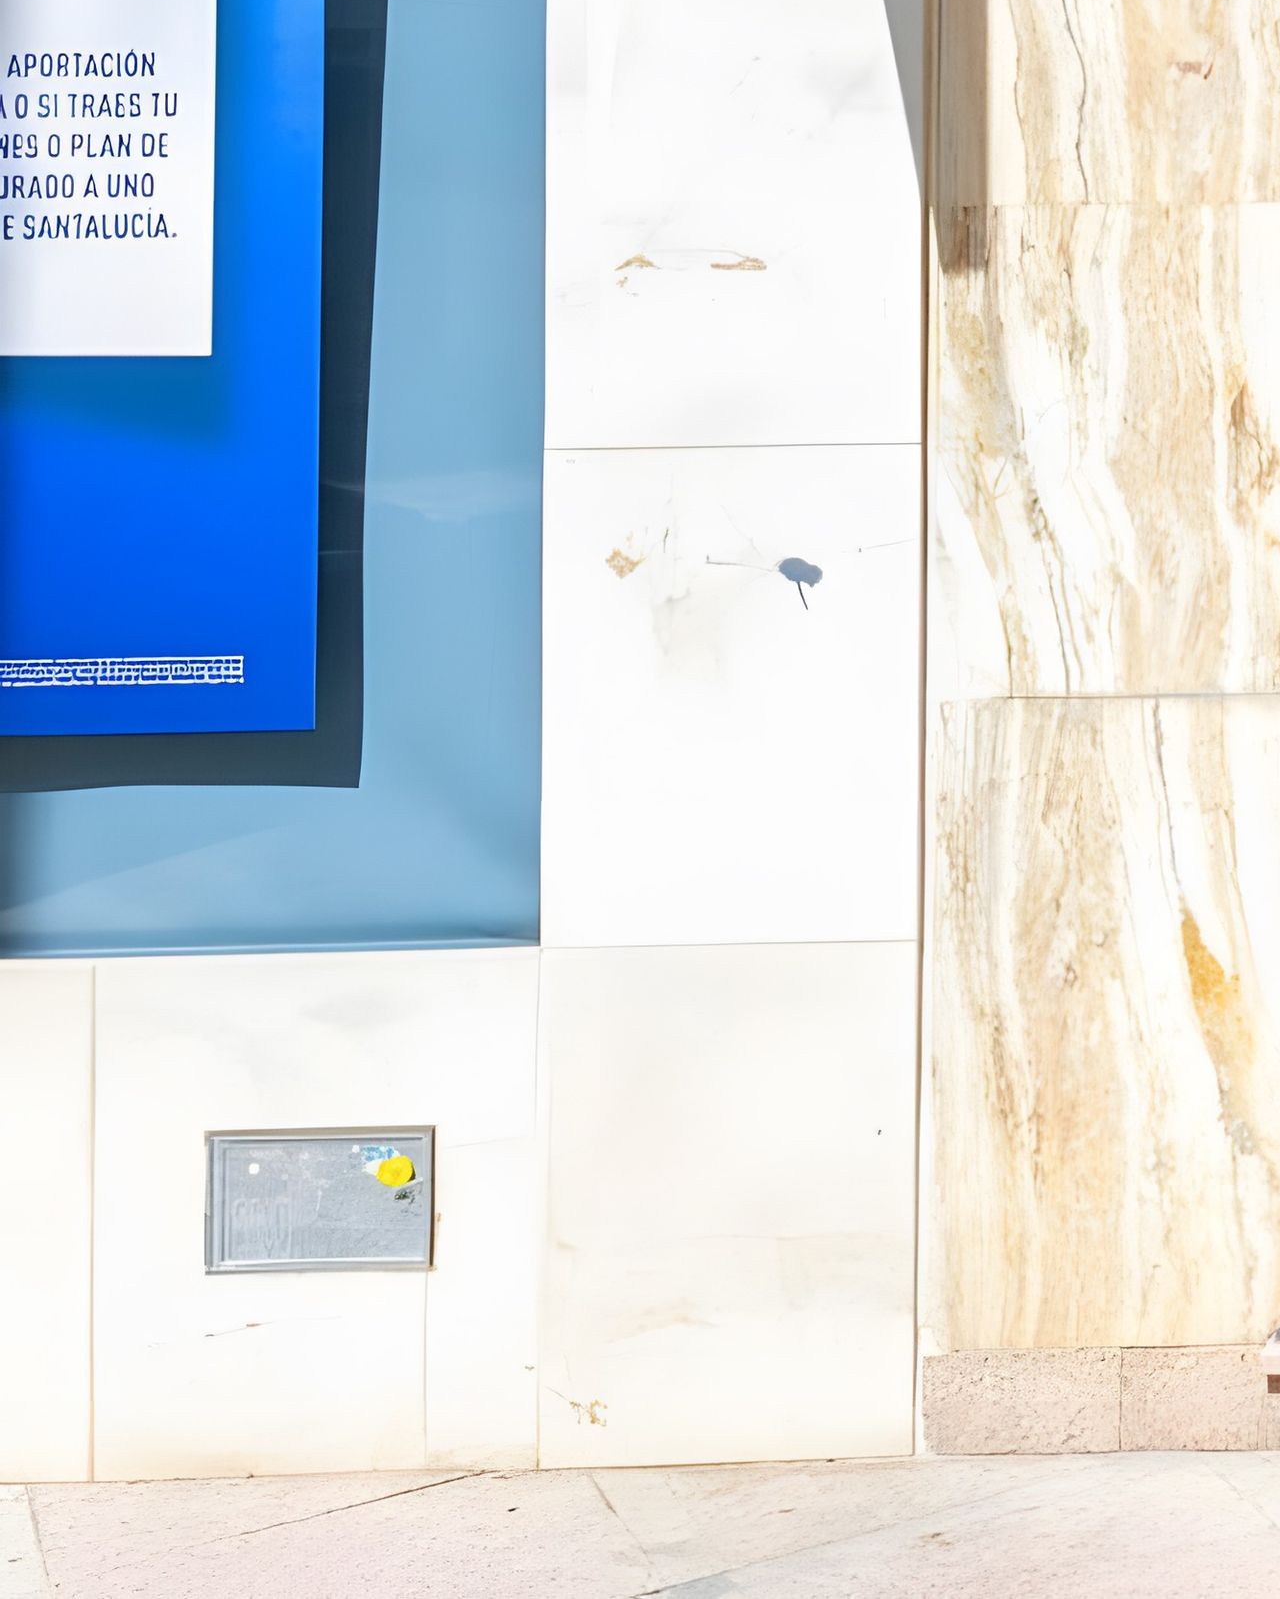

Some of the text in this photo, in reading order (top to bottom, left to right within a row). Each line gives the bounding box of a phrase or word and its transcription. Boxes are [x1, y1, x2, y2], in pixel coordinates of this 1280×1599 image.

[7, 49, 155, 78] APORTACIÓN
[15, 94, 28, 119] O
[37, 93, 58, 118] SI
[152, 93, 177, 117] TU
[48, 134, 60, 157] O
[72, 133, 131, 158] PLAN
[142, 133, 168, 157] DE
[84, 174, 98, 198] A
[108, 173, 154, 197] UNO
